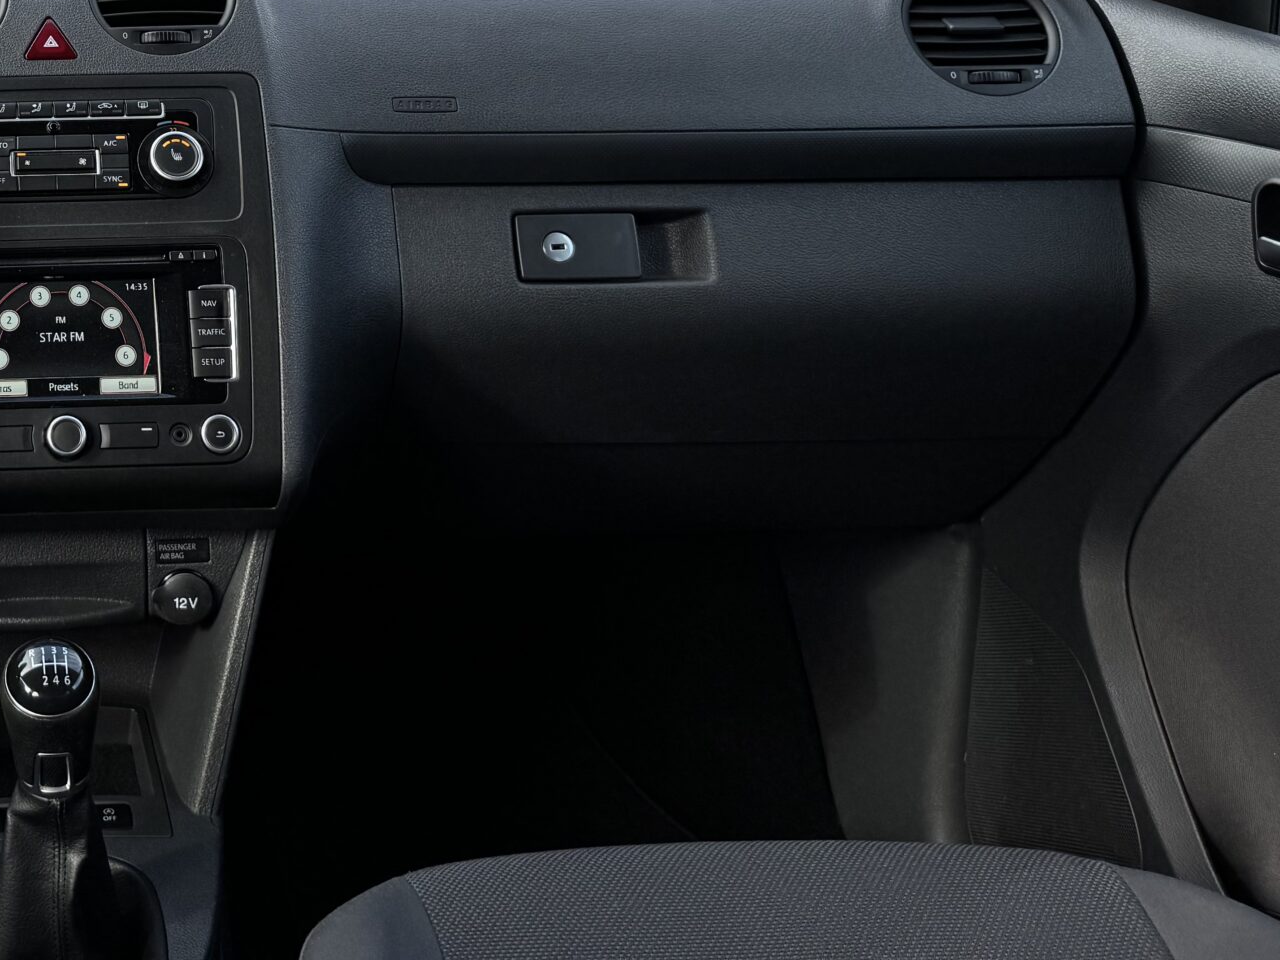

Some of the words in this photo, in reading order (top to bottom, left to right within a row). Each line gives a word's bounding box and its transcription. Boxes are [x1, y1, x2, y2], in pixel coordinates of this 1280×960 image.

[103, 175, 124, 183] SYNC
[125, 283, 148, 291] 14:35
[37, 292, 43, 300] 3
[76, 291, 82, 299] 4
[6, 316, 12, 325] 2
[55, 316, 66, 324] FM
[109, 313, 115, 322] 5
[197, 328, 226, 336] TRAFFIC
[39, 332, 67, 343] STAR
[70, 332, 85, 342] FM
[123, 351, 129, 360] 6
[201, 358, 226, 366] SETUP
[49, 382, 79, 391] Presets
[118, 381, 139, 389] Band
[159, 543, 197, 551] PASSENGER
[42, 675, 49, 686] 2
[53, 675, 60, 685] 4
[64, 675, 71, 685] 6
